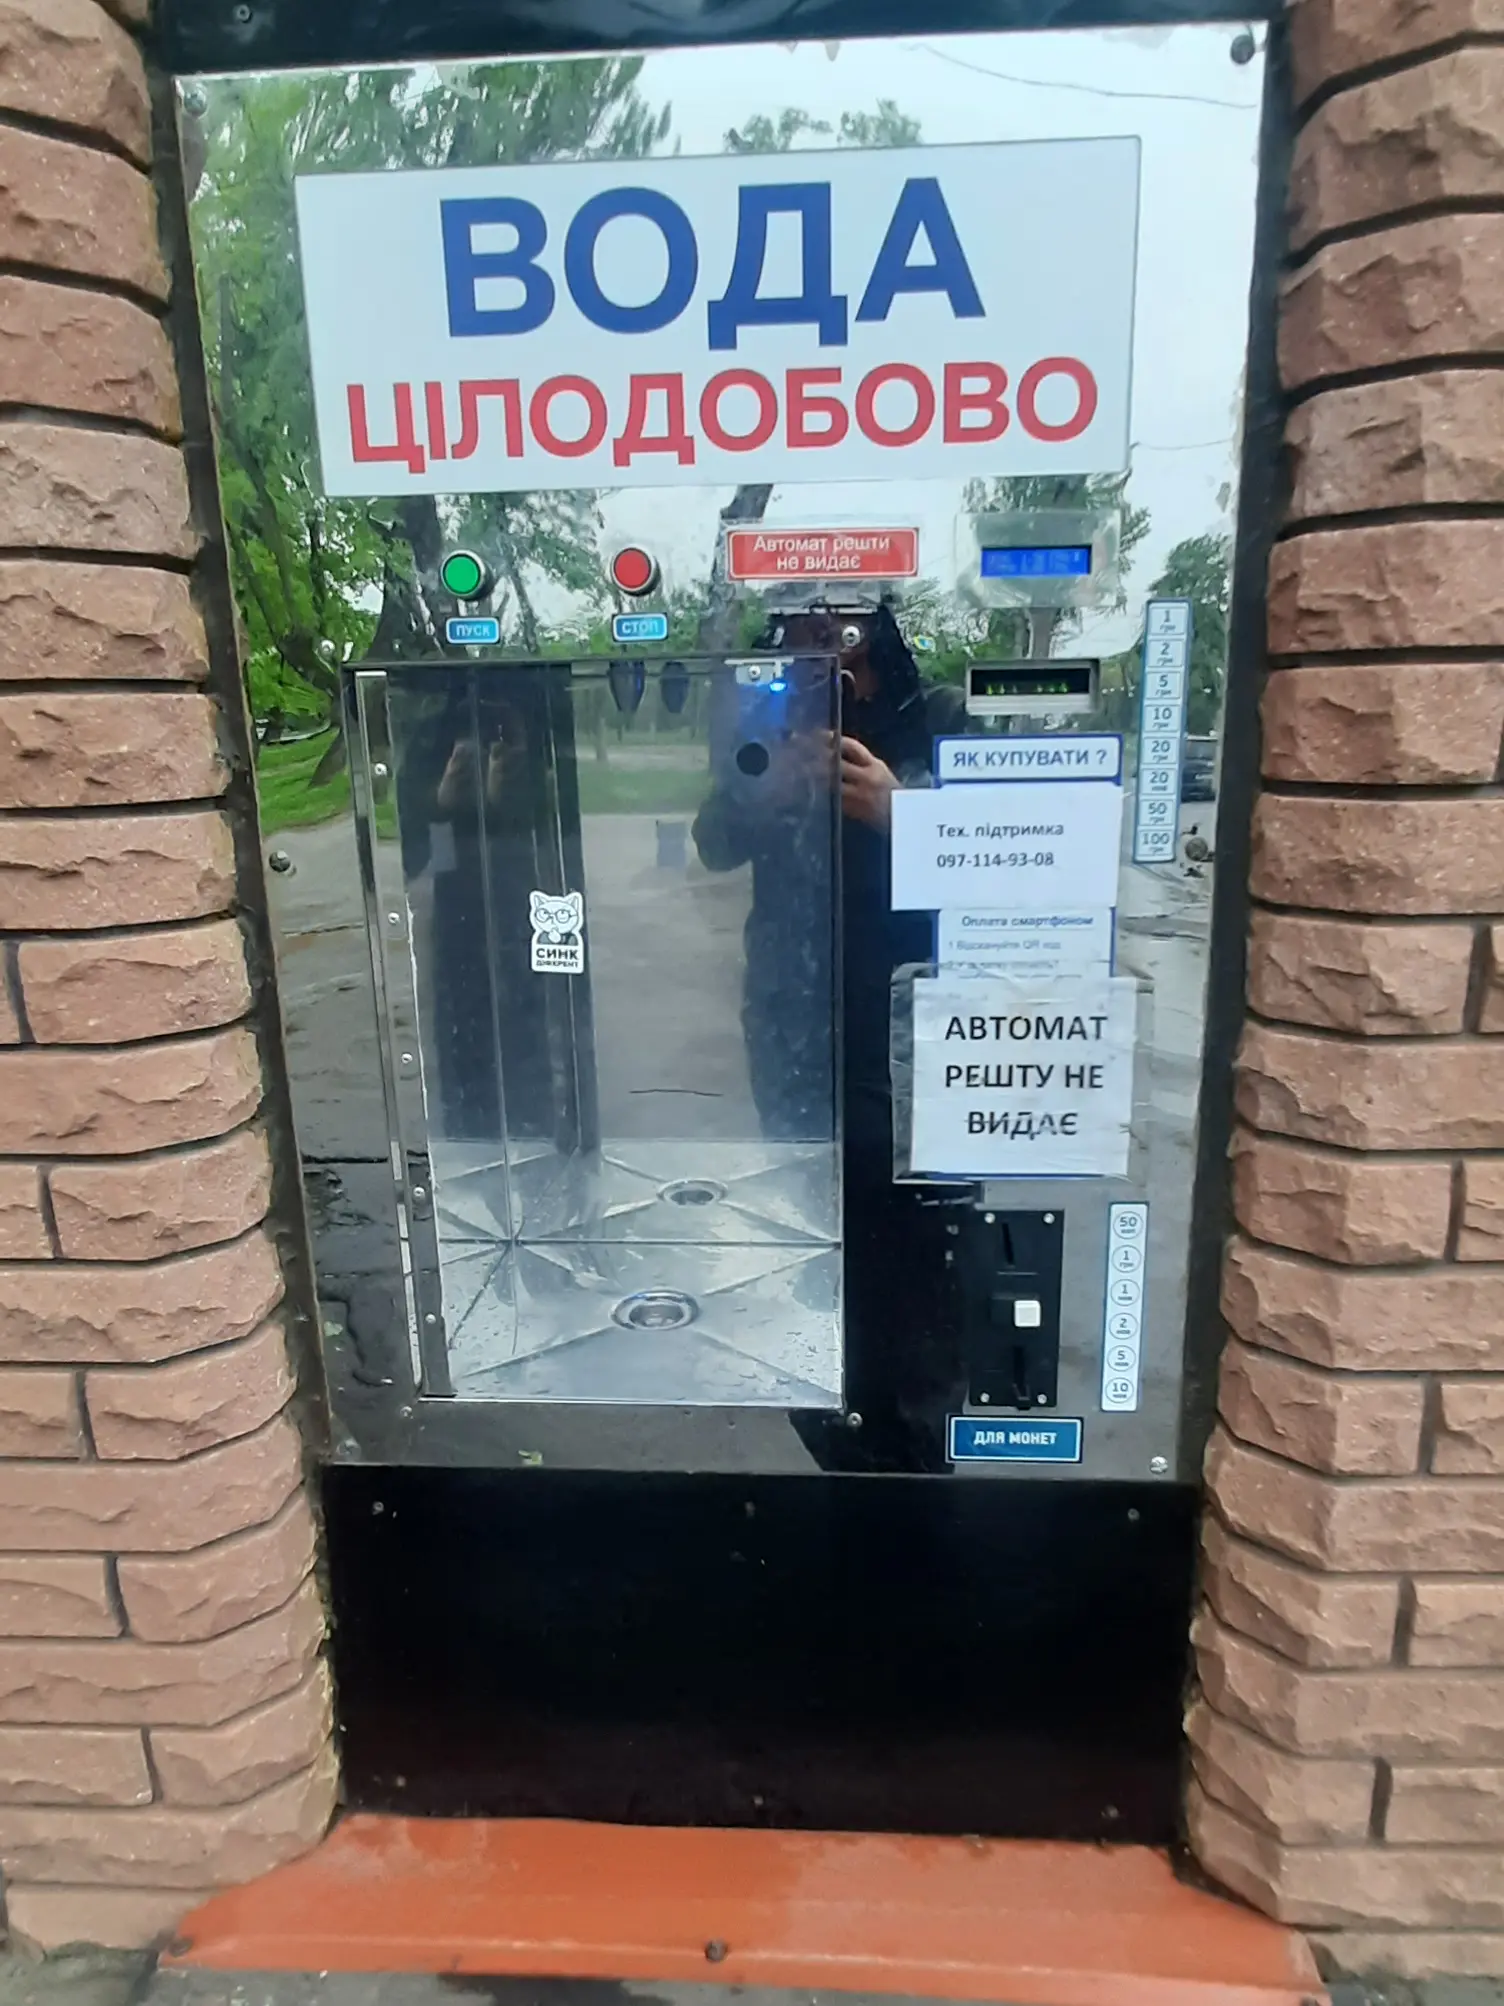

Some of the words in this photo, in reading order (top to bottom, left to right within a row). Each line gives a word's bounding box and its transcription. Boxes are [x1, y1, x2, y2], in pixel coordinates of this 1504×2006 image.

[439, 176, 986, 351] ВОДА
[346, 356, 1098, 474] ЦІЛОДОБОВО
[753, 535, 826, 552] Автомат
[833, 537, 889, 554] решти
[776, 556, 798, 570] не
[804, 555, 861, 572] видає
[1163, 610, 1171, 622] 1
[455, 623, 490, 637] ПУСК
[622, 619, 659, 635] СТОП
[1160, 643, 1170, 655] 2
[1159, 675, 1168, 687] 5
[1153, 708, 1172, 721] 10
[1151, 741, 1170, 753] 20
[953, 751, 979, 767] ЯК
[985, 749, 1089, 766] КУПУВАТИ
[1096, 749, 1107, 765] ?
[1150, 772, 1168, 784] 20
[1148, 803, 1167, 814] 50
[937, 823, 969, 838] Тех.
[975, 822, 1064, 839] підтримка
[1142, 833, 1169, 845] 100
[936, 853, 1055, 868] 097-114-93-08
[962, 916, 1008, 927] Оплата
[1011, 915, 1094, 928] смартфоном
[536, 948, 579, 960] СИНК
[945, 1016, 1109, 1041] АВТОМАТ
[945, 1064, 1055, 1088] РЕШТУ
[1064, 1065, 1104, 1088] НЕ
[967, 1111, 1079, 1140] ВИДАЄ
[1119, 1216, 1137, 1227] 50
[1123, 1250, 1129, 1261] 1
[1121, 1284, 1128, 1294] 1
[1119, 1318, 1127, 1328] 2
[1117, 1350, 1126, 1360] 5
[1112, 1382, 1129, 1392] 10
[973, 1431, 1006, 1446] ДЛЯ
[1009, 1432, 1057, 1444] МОНЕТ
